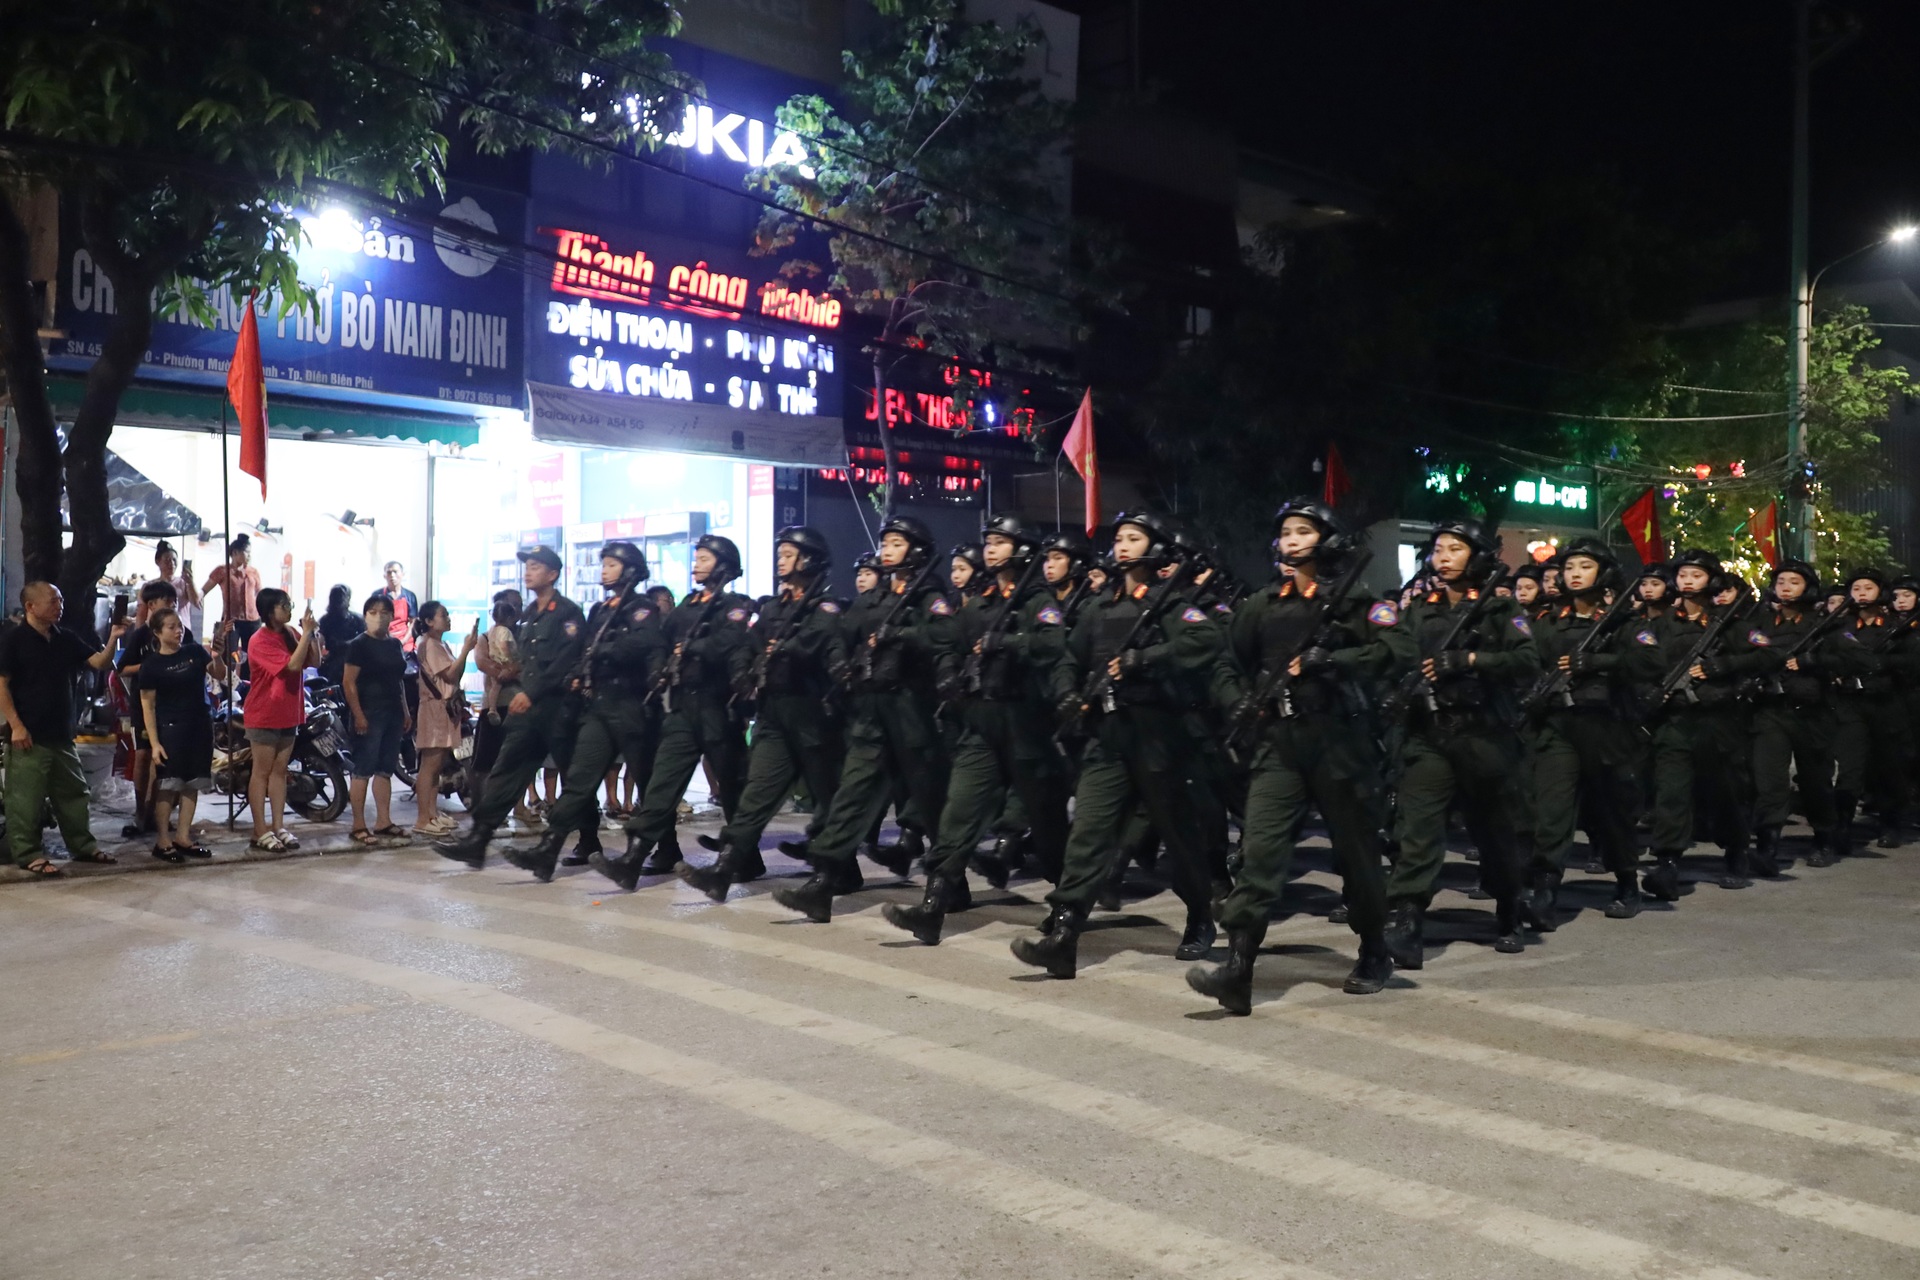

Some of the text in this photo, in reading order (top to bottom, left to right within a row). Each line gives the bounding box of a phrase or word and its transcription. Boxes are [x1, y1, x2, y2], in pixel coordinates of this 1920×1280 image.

[341, 280, 376, 351] BÒ
[384, 297, 443, 360] NAM
[449, 309, 507, 377] ĐỊNH
[547, 298, 612, 347] ĐIỆN
[615, 310, 693, 360] THOẠI
[727, 329, 776, 373] PHỤ
[67, 340, 84, 354] SN
[163, 352, 204, 370] Phường
[207, 357, 231, 372] Mườ
[287, 367, 303, 381] Tp.
[330, 373, 352, 387] Biên
[354, 375, 374, 389] Phủ
[569, 346, 624, 393] SỬA
[626, 361, 693, 401] CHỮA
[536, 407, 578, 425] Galaxy
[629, 419, 645, 430] 5G
[917, 391, 974, 432] THO
